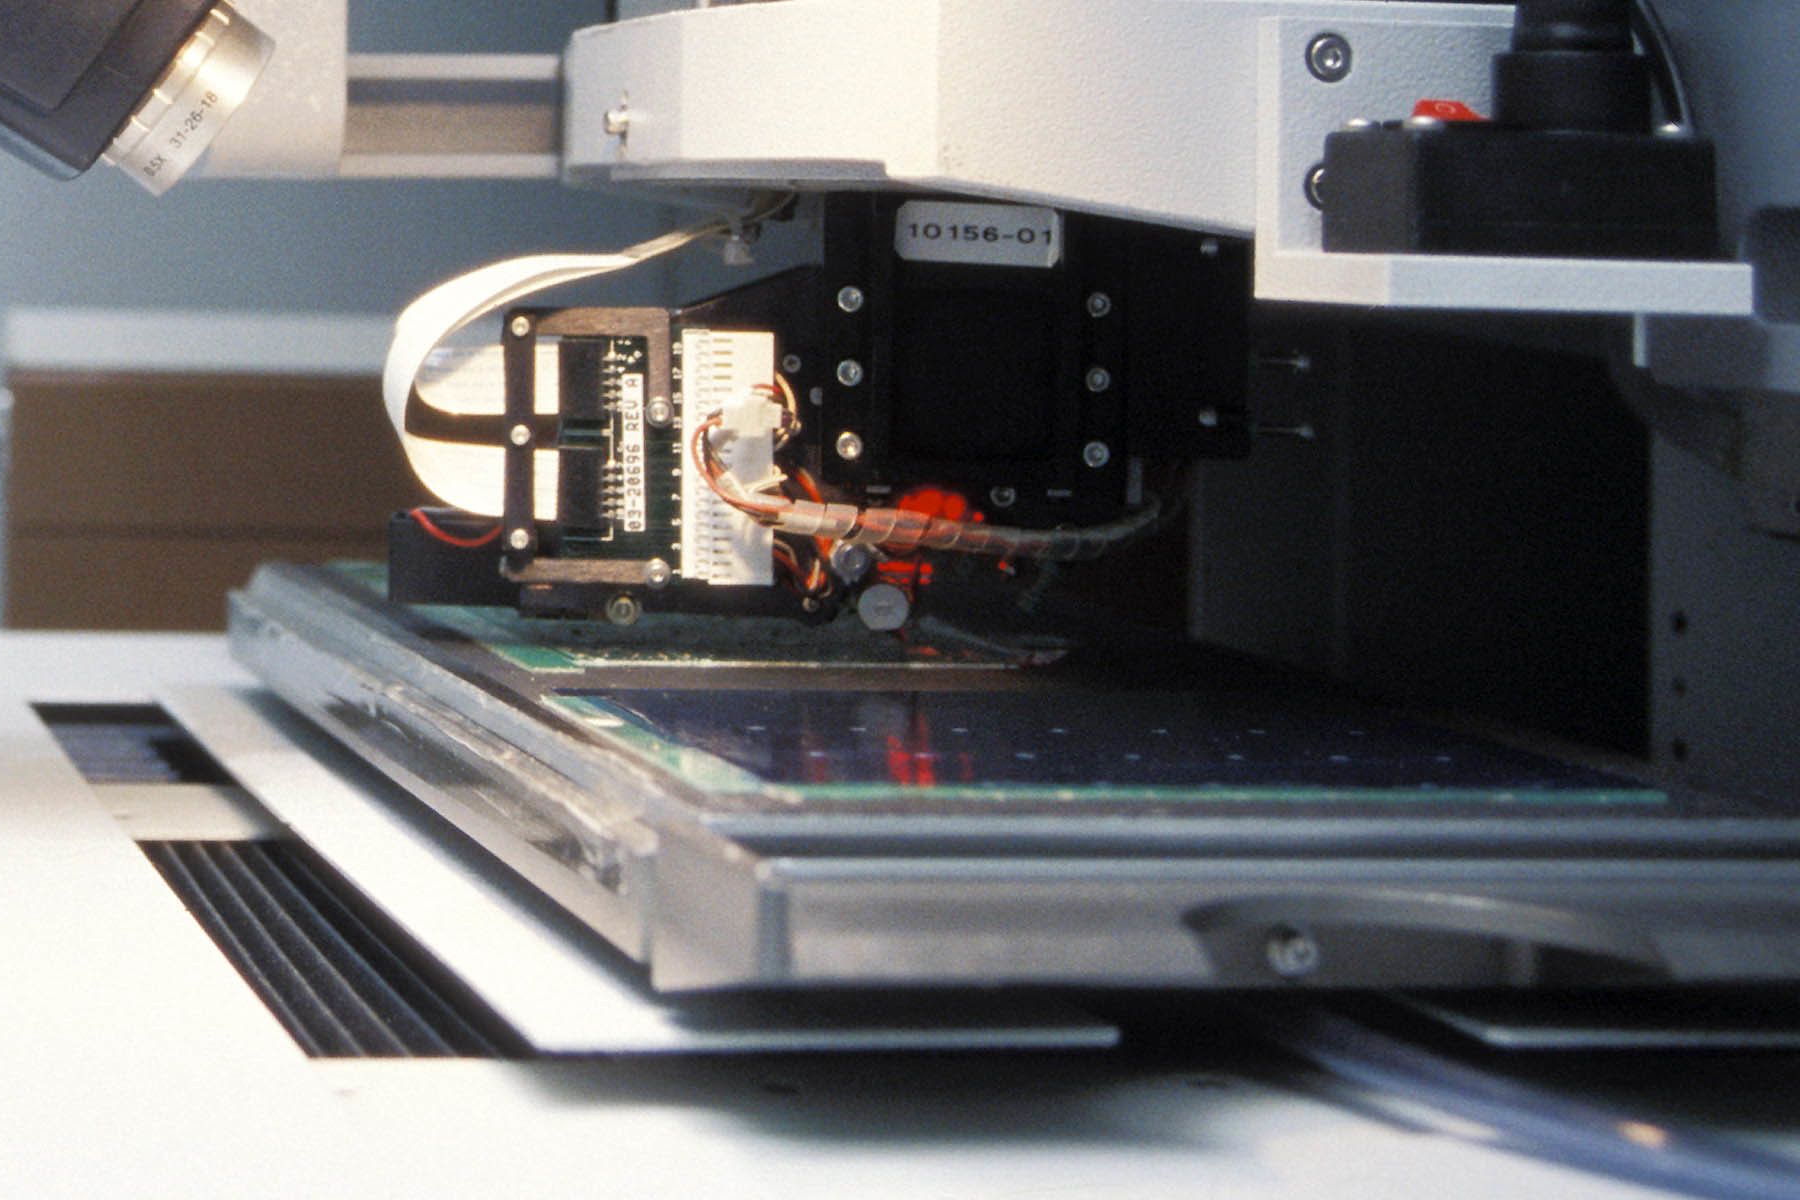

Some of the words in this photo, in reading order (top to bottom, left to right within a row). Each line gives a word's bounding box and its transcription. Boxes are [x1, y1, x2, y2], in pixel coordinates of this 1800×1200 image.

[906, 223, 1053, 246] 10156-01
[624, 378, 638, 388] A
[624, 400, 640, 432] REV
[625, 444, 643, 530] 03-20696
